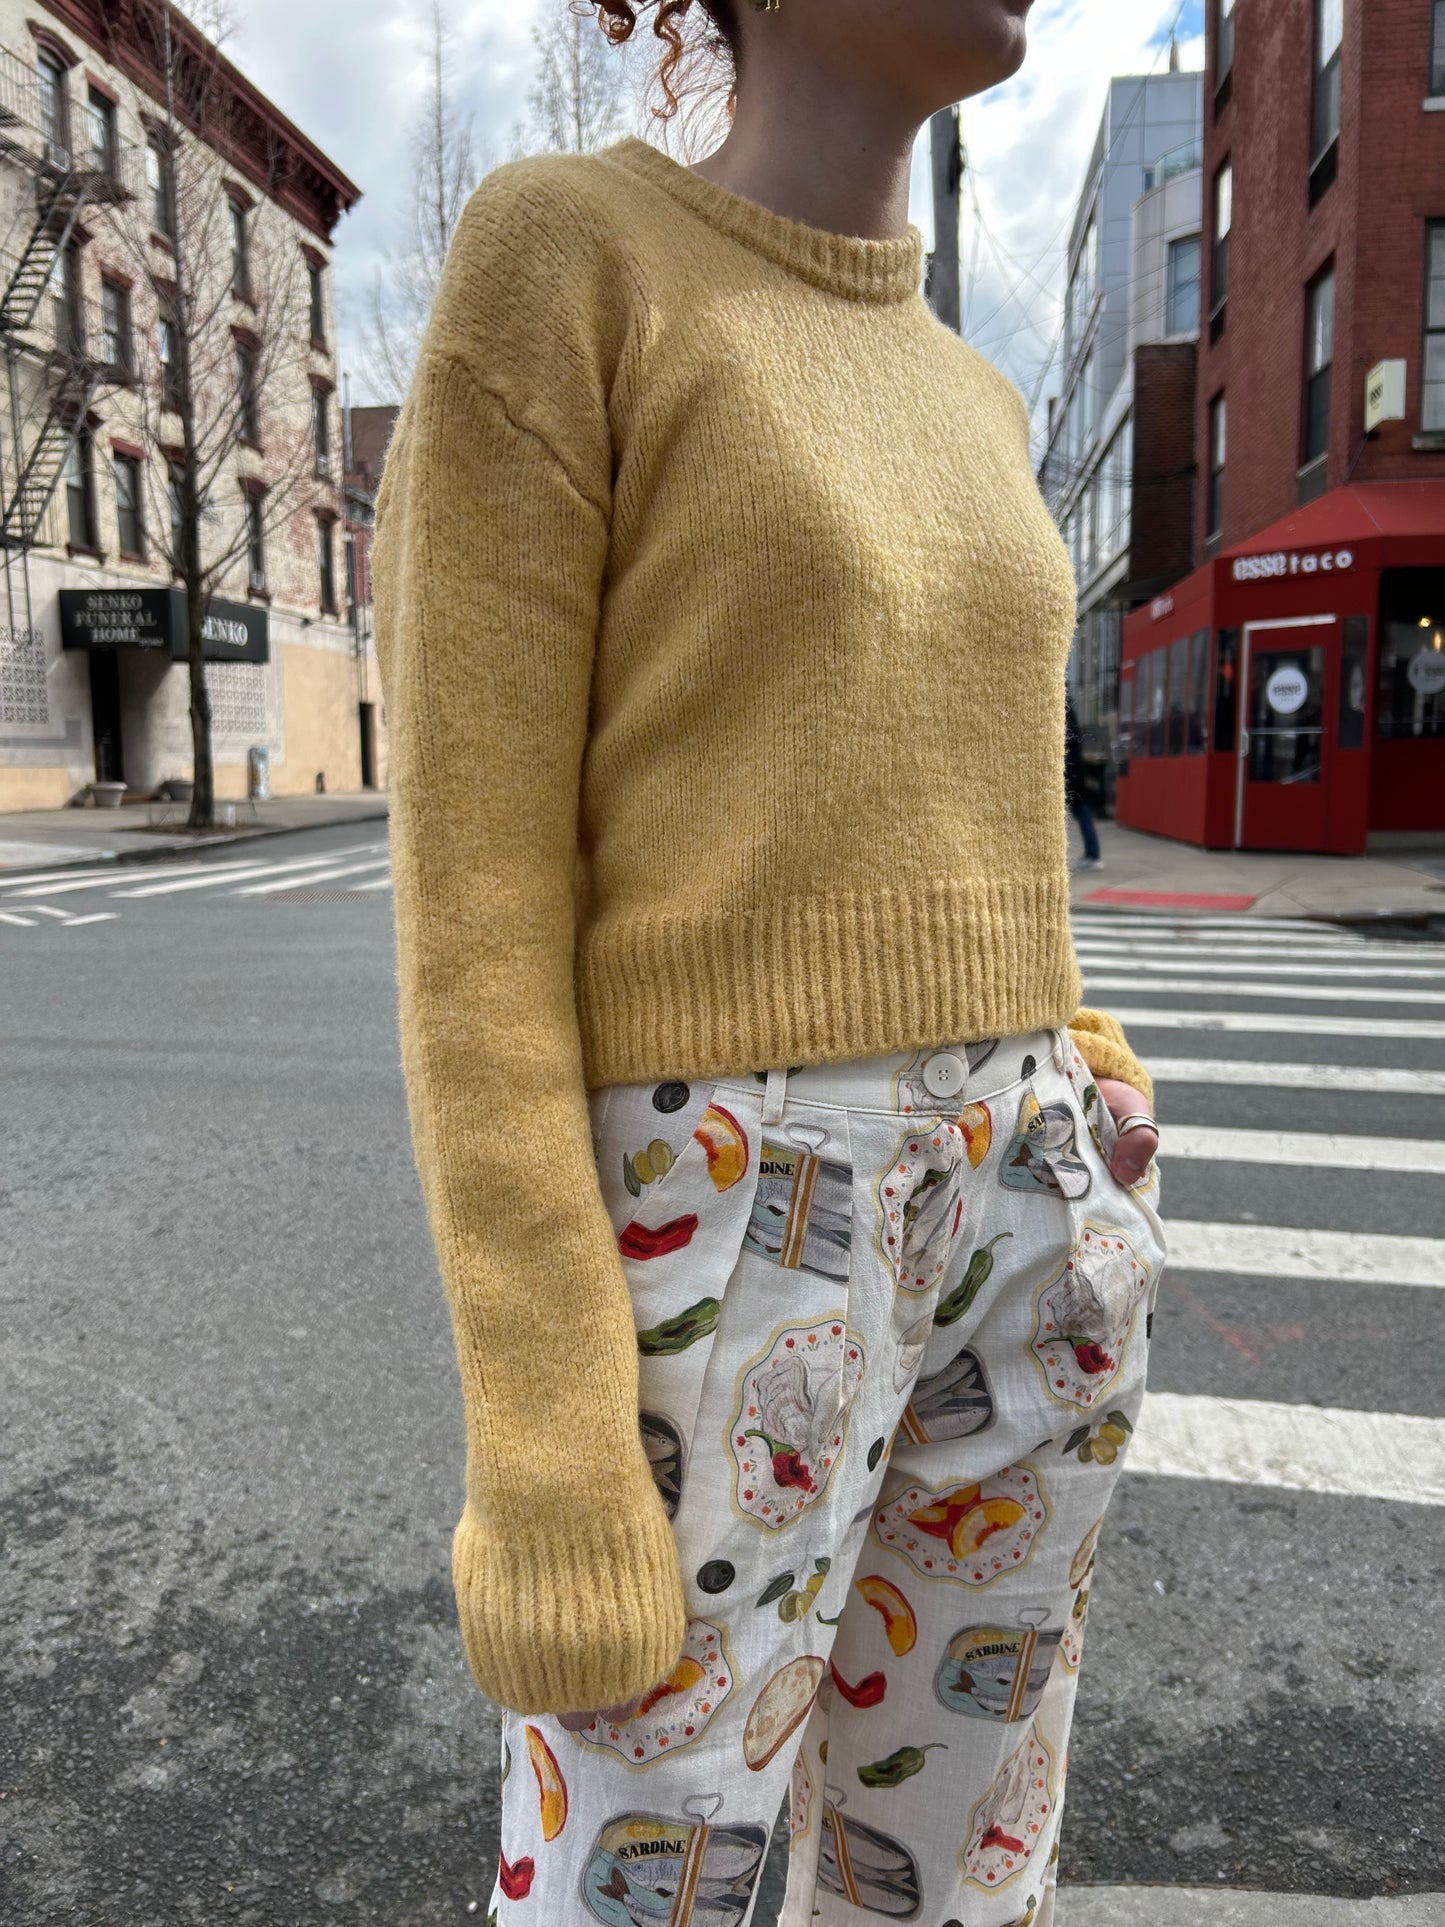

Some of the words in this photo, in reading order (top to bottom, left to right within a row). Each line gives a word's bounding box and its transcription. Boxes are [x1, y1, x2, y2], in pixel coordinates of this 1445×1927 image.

[1289, 549, 1353, 575] taco
[85, 594, 143, 610] SENKO
[73, 610, 157, 627] FUNERAL
[91, 627, 140, 642] HOME
[965, 1643, 1020, 1661] SARDINE
[618, 1840, 686, 1860] SARDINE
